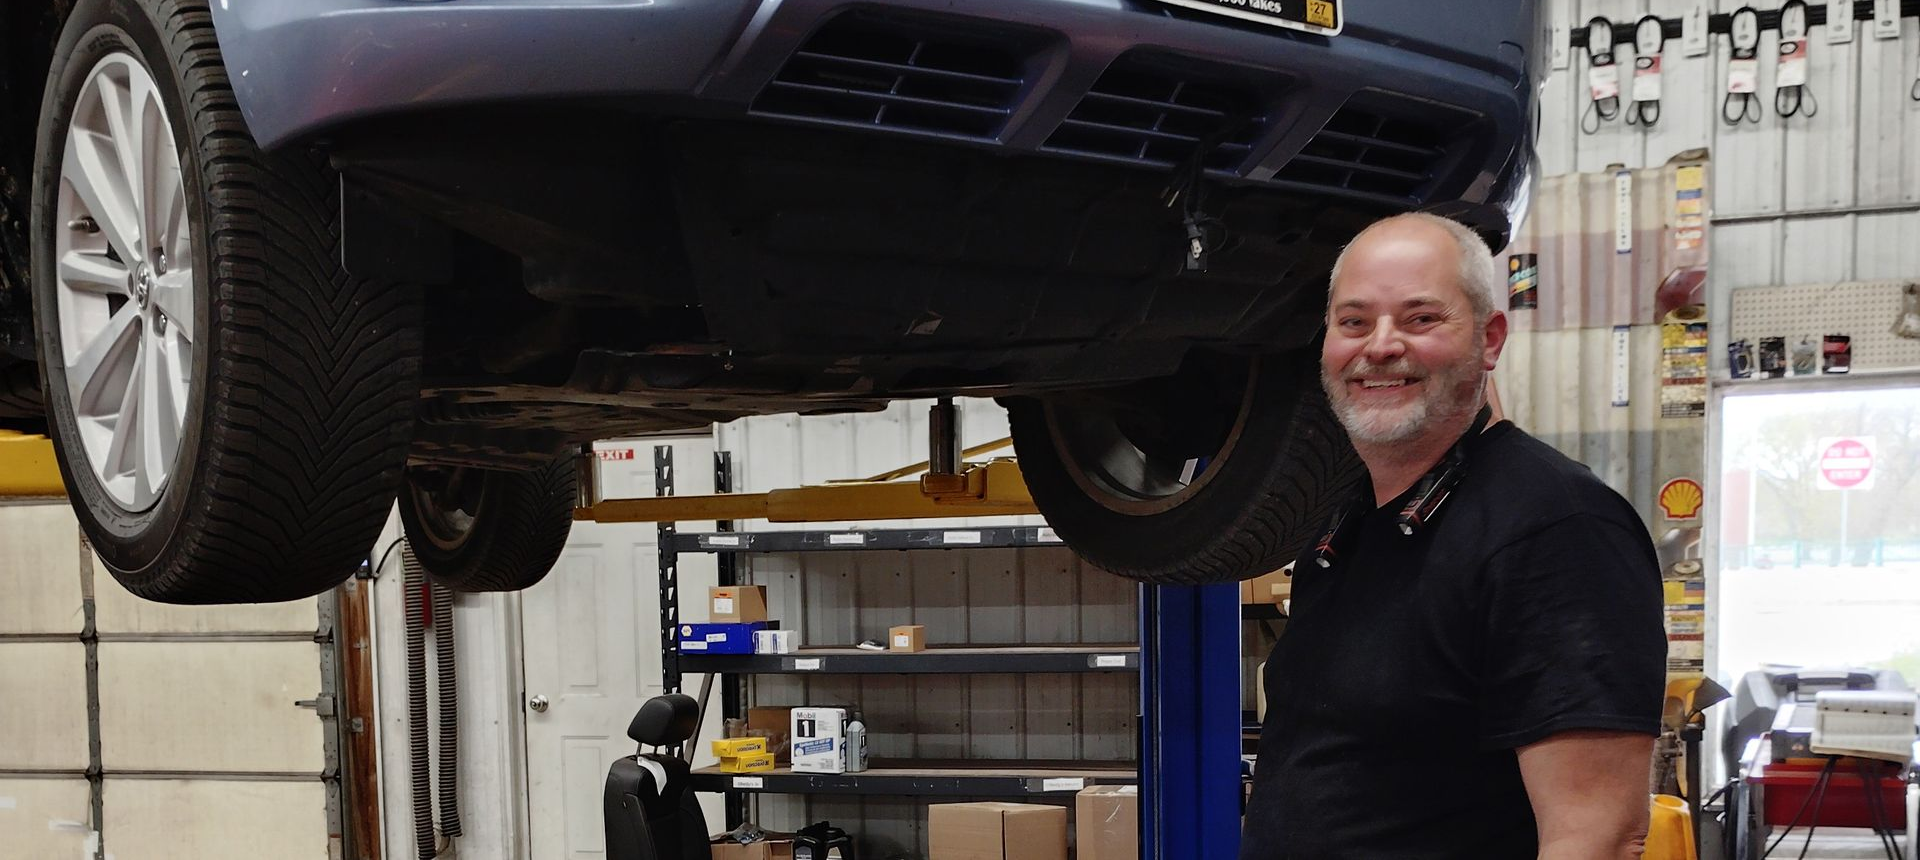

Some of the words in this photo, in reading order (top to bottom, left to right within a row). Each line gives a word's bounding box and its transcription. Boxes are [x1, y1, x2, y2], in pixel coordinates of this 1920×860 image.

[1314, 2, 1326, 15] 27
[596, 450, 628, 460] EXIT
[802, 720, 810, 737] 1
